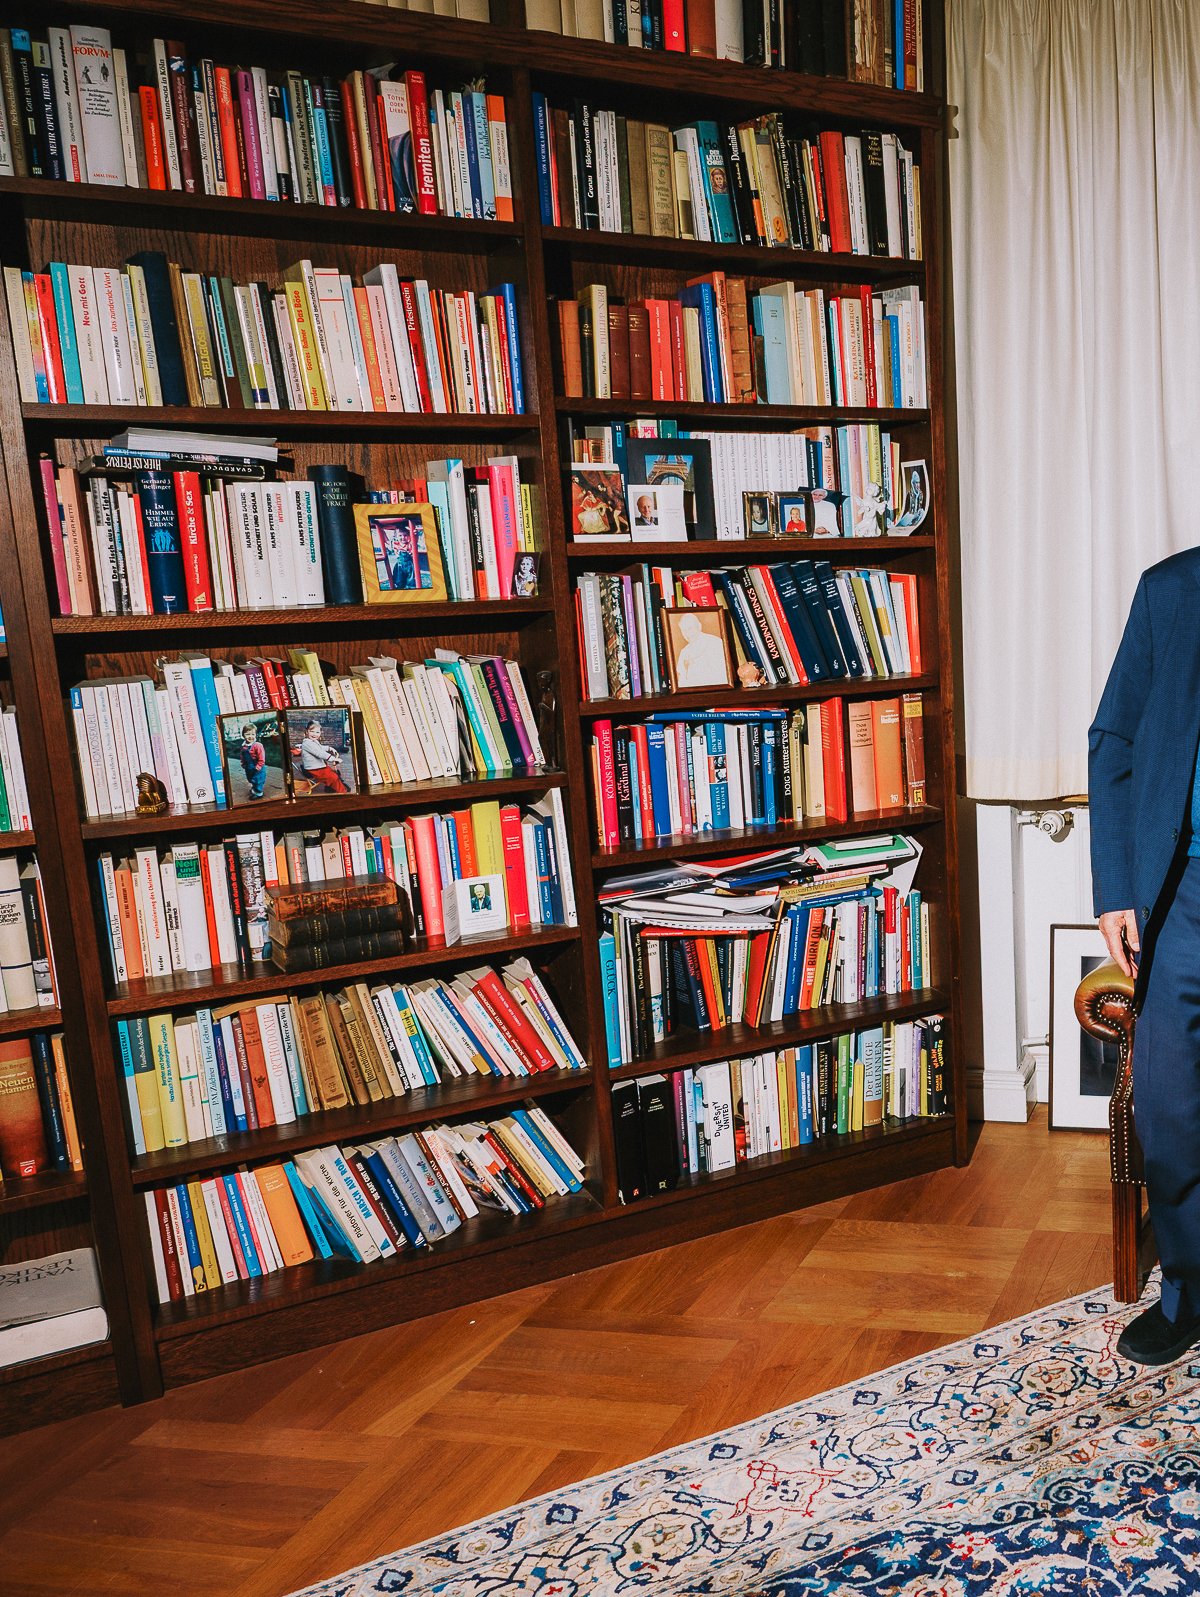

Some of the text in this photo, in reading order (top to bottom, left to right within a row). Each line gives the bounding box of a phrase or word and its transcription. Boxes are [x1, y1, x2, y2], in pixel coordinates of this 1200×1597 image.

[20, 57, 30, 85] verrückt
[58, 36, 70, 96] Anders gesehen
[158, 58, 166, 76] Köln
[22, 88, 30, 96] ist
[42, 78, 50, 100] HERR
[293, 80, 303, 118] Badewanne
[44, 102, 54, 131] OPIUM,
[161, 86, 172, 120] Minnesota
[582, 106, 590, 126] Bingen
[296, 120, 304, 131] der
[48, 132, 58, 156] MEHR
[168, 129, 178, 171] Zander/Brunn
[300, 139, 310, 170] Napoleon
[584, 140, 592, 168] Hildegard
[728, 126, 740, 160] Dominikus
[777, 122, 786, 147] Elisabeth
[782, 160, 791, 188] Thüringen
[418, 138, 434, 195] Eremiten
[78, 277, 90, 326] Neu mit Gott
[104, 272, 118, 332] Das zündende Wort
[292, 290, 301, 308] Böse
[306, 276, 318, 312] Behinderung
[296, 310, 304, 322] Das
[403, 287, 416, 330] Priestersein
[848, 302, 856, 338] EMMERICH
[300, 329, 308, 348] Rahner
[360, 304, 376, 365] Sammle deine Kraft
[196, 330, 212, 376] RELIGIÖSE
[310, 387, 318, 406] Herder
[105, 455, 162, 471] HIER IST PETRUS
[184, 490, 194, 506] Sex
[250, 492, 258, 513] SCHAM
[276, 493, 284, 522] INTIMITÄT
[304, 491, 312, 513] GEWALT
[67, 504, 76, 522] KETTE
[240, 492, 252, 548] HANS PETER DUERR
[70, 524, 78, 536] DER
[187, 517, 198, 544] Kirche
[73, 545, 82, 571] SPRUNG
[108, 544, 116, 563] Fisch
[254, 529, 263, 560] NACKTHEIT
[110, 566, 118, 579] Der
[747, 588, 780, 659] KARDINAL FRINGS
[87, 713, 102, 766] HOMOSEXUELL
[781, 720, 789, 744] Teres
[602, 728, 614, 799] KÖLNS BISCHÖFE
[782, 744, 790, 774] Mutter
[619, 763, 630, 800] Kardinal
[227, 850, 236, 872] Kirche?
[810, 926, 820, 938] ON
[808, 941, 818, 966] BURN
[120, 1031, 130, 1066] GESELLSCHAFT
[236, 1028, 248, 1070] GottesPastoral
[262, 1012, 282, 1076] ORTHODOXIE
[388, 1042, 396, 1051] Die
[883, 1037, 894, 1074] MORAL
[866, 1042, 874, 1098] Der EWIGE
[874, 1040, 882, 1096] BRUNNEN
[0, 1077, 34, 1090] Neuen
[402, 1076, 410, 1090] Peter
[712, 1102, 724, 1137] DIVERSITY
[722, 1103, 730, 1129] UNITED
[388, 1150, 400, 1164] NEIN
[367, 1182, 376, 1193] SAAT
[398, 1166, 408, 1183] KIRCHE
[318, 1164, 364, 1238] Plädoyer für die Kirche
[334, 1158, 372, 1219] MARSCH AUF ROM
[412, 1192, 422, 1206] GOTT
[170, 1193, 178, 1220] AUSLÖSCHEN
[0, 1258, 73, 1281] LEXIKO
[0, 1266, 74, 1286] VATIKA
